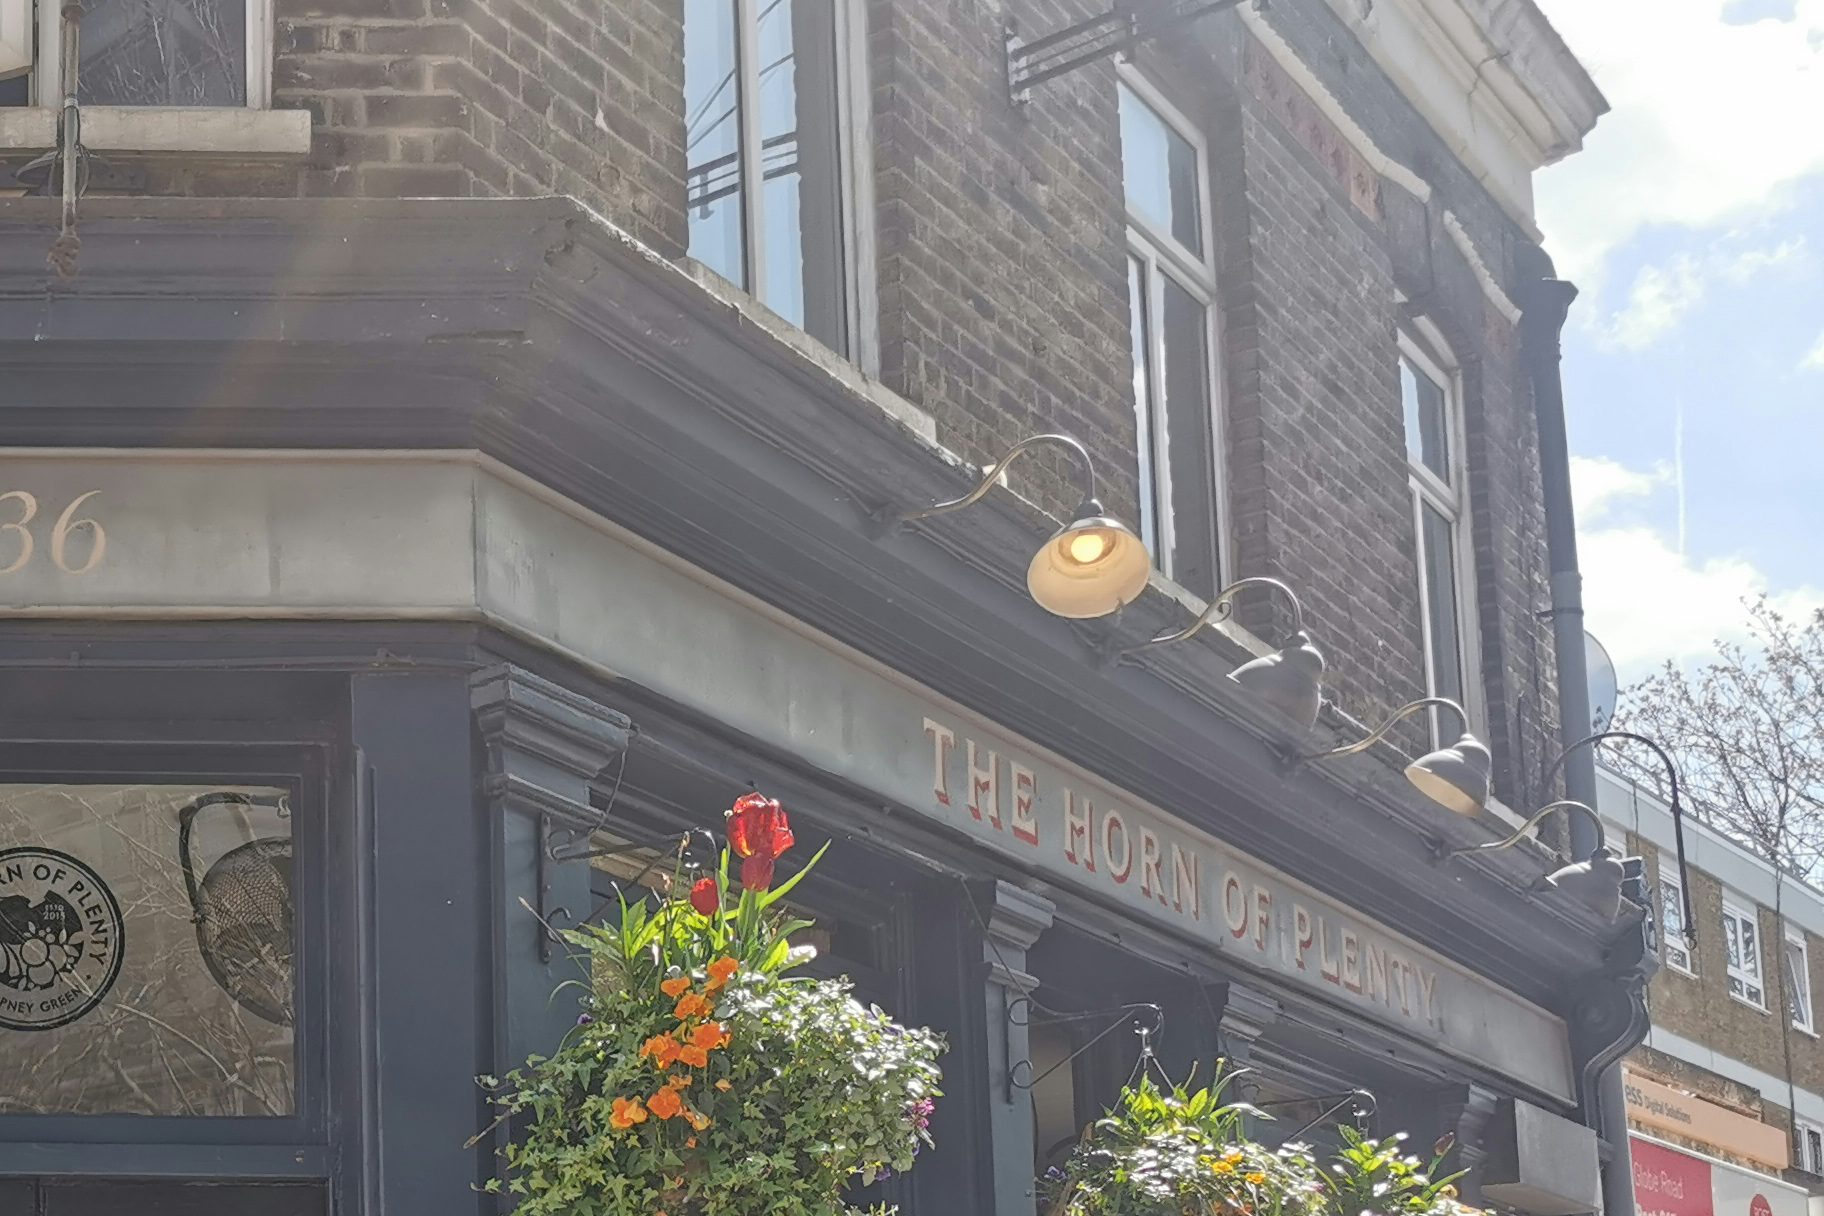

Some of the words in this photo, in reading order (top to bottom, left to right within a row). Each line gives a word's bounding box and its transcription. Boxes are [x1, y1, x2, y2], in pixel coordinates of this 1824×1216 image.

[923, 716, 1039, 847] THE
[1062, 787, 1202, 922] HORN
[1222, 870, 1273, 951] OF
[1293, 903, 1440, 1027] PLENTY
[33, 864, 67, 885] OF
[68, 880, 109, 966] PLENTY
[40, 985, 83, 1013] GREEN
[1625, 1084, 1643, 1107] ess
[1644, 1095, 1664, 1115] Digital
[1664, 1102, 1693, 1125] Solutions
[1633, 1161, 1659, 1192] Globe
[1661, 1170, 1684, 1200] Road
